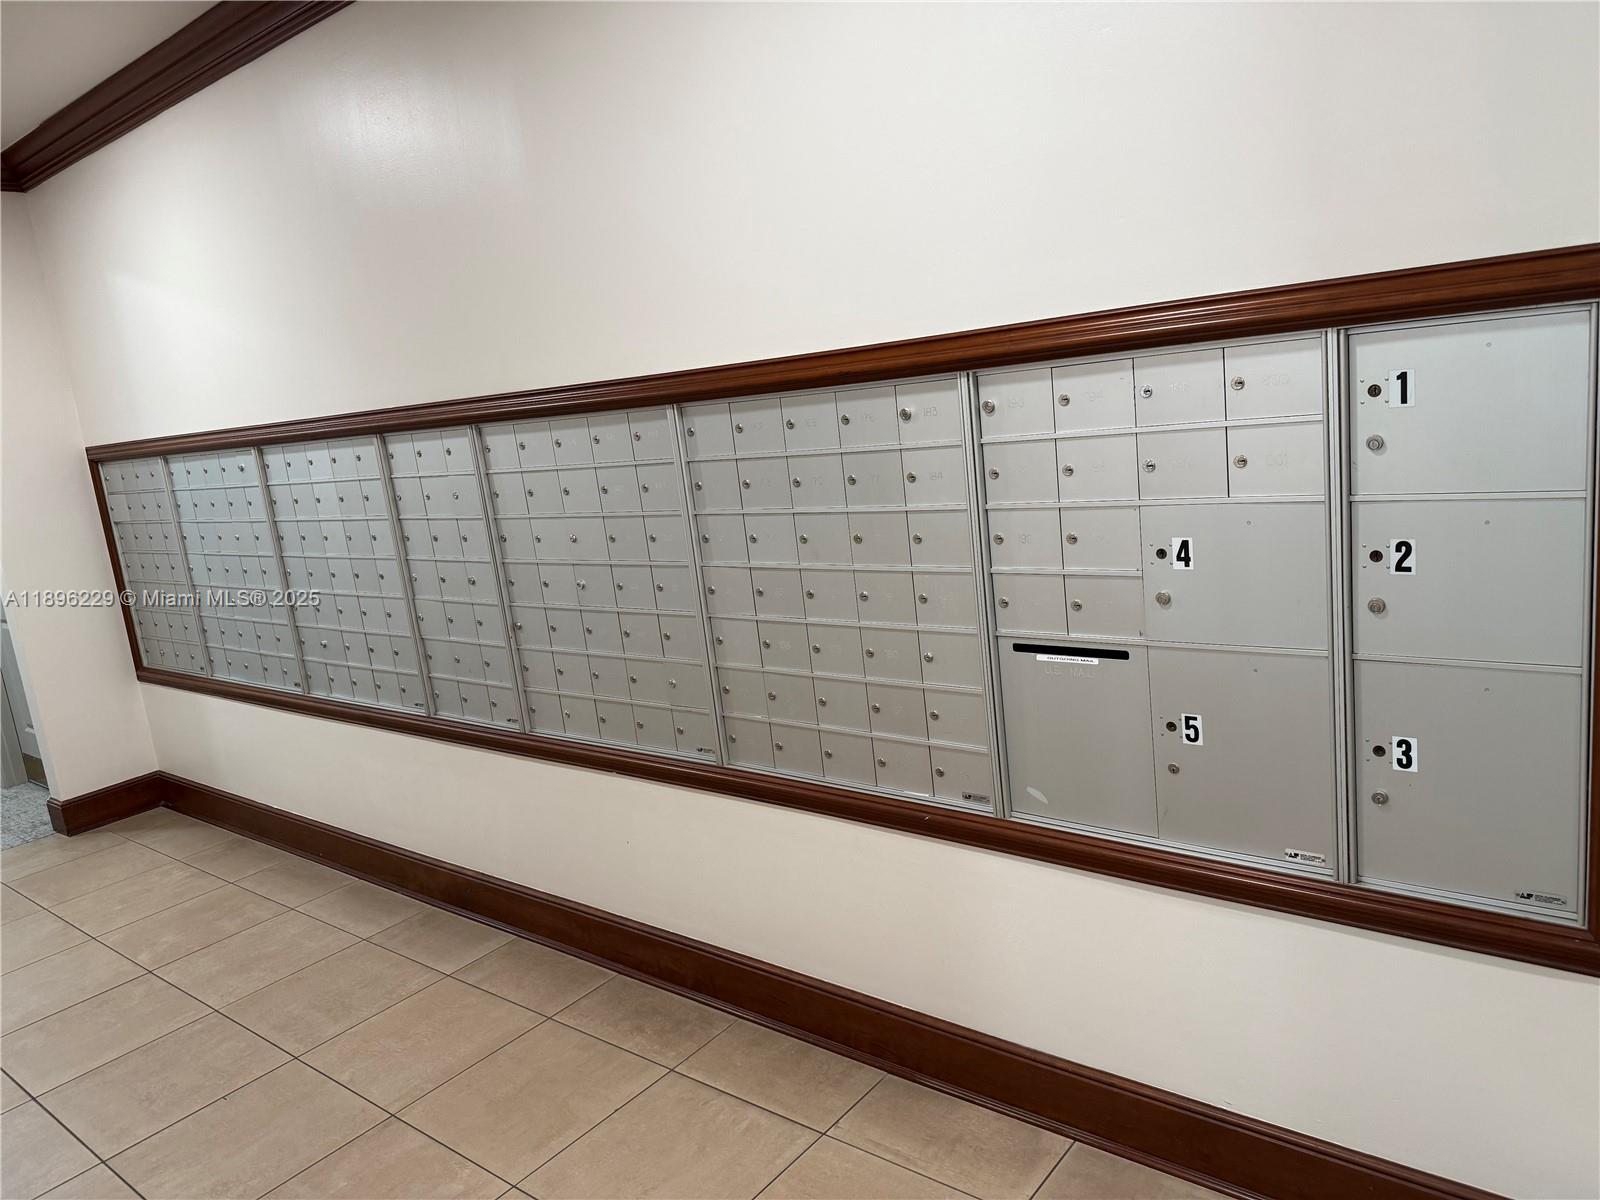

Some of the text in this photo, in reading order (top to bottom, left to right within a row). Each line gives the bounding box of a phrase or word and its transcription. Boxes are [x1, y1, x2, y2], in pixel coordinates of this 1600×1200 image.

[1396, 371, 1408, 405] 1
[1175, 539, 1192, 568] 4
[1394, 540, 1413, 573] 2
[1184, 715, 1200, 743] 5
[1396, 738, 1413, 770] 3
